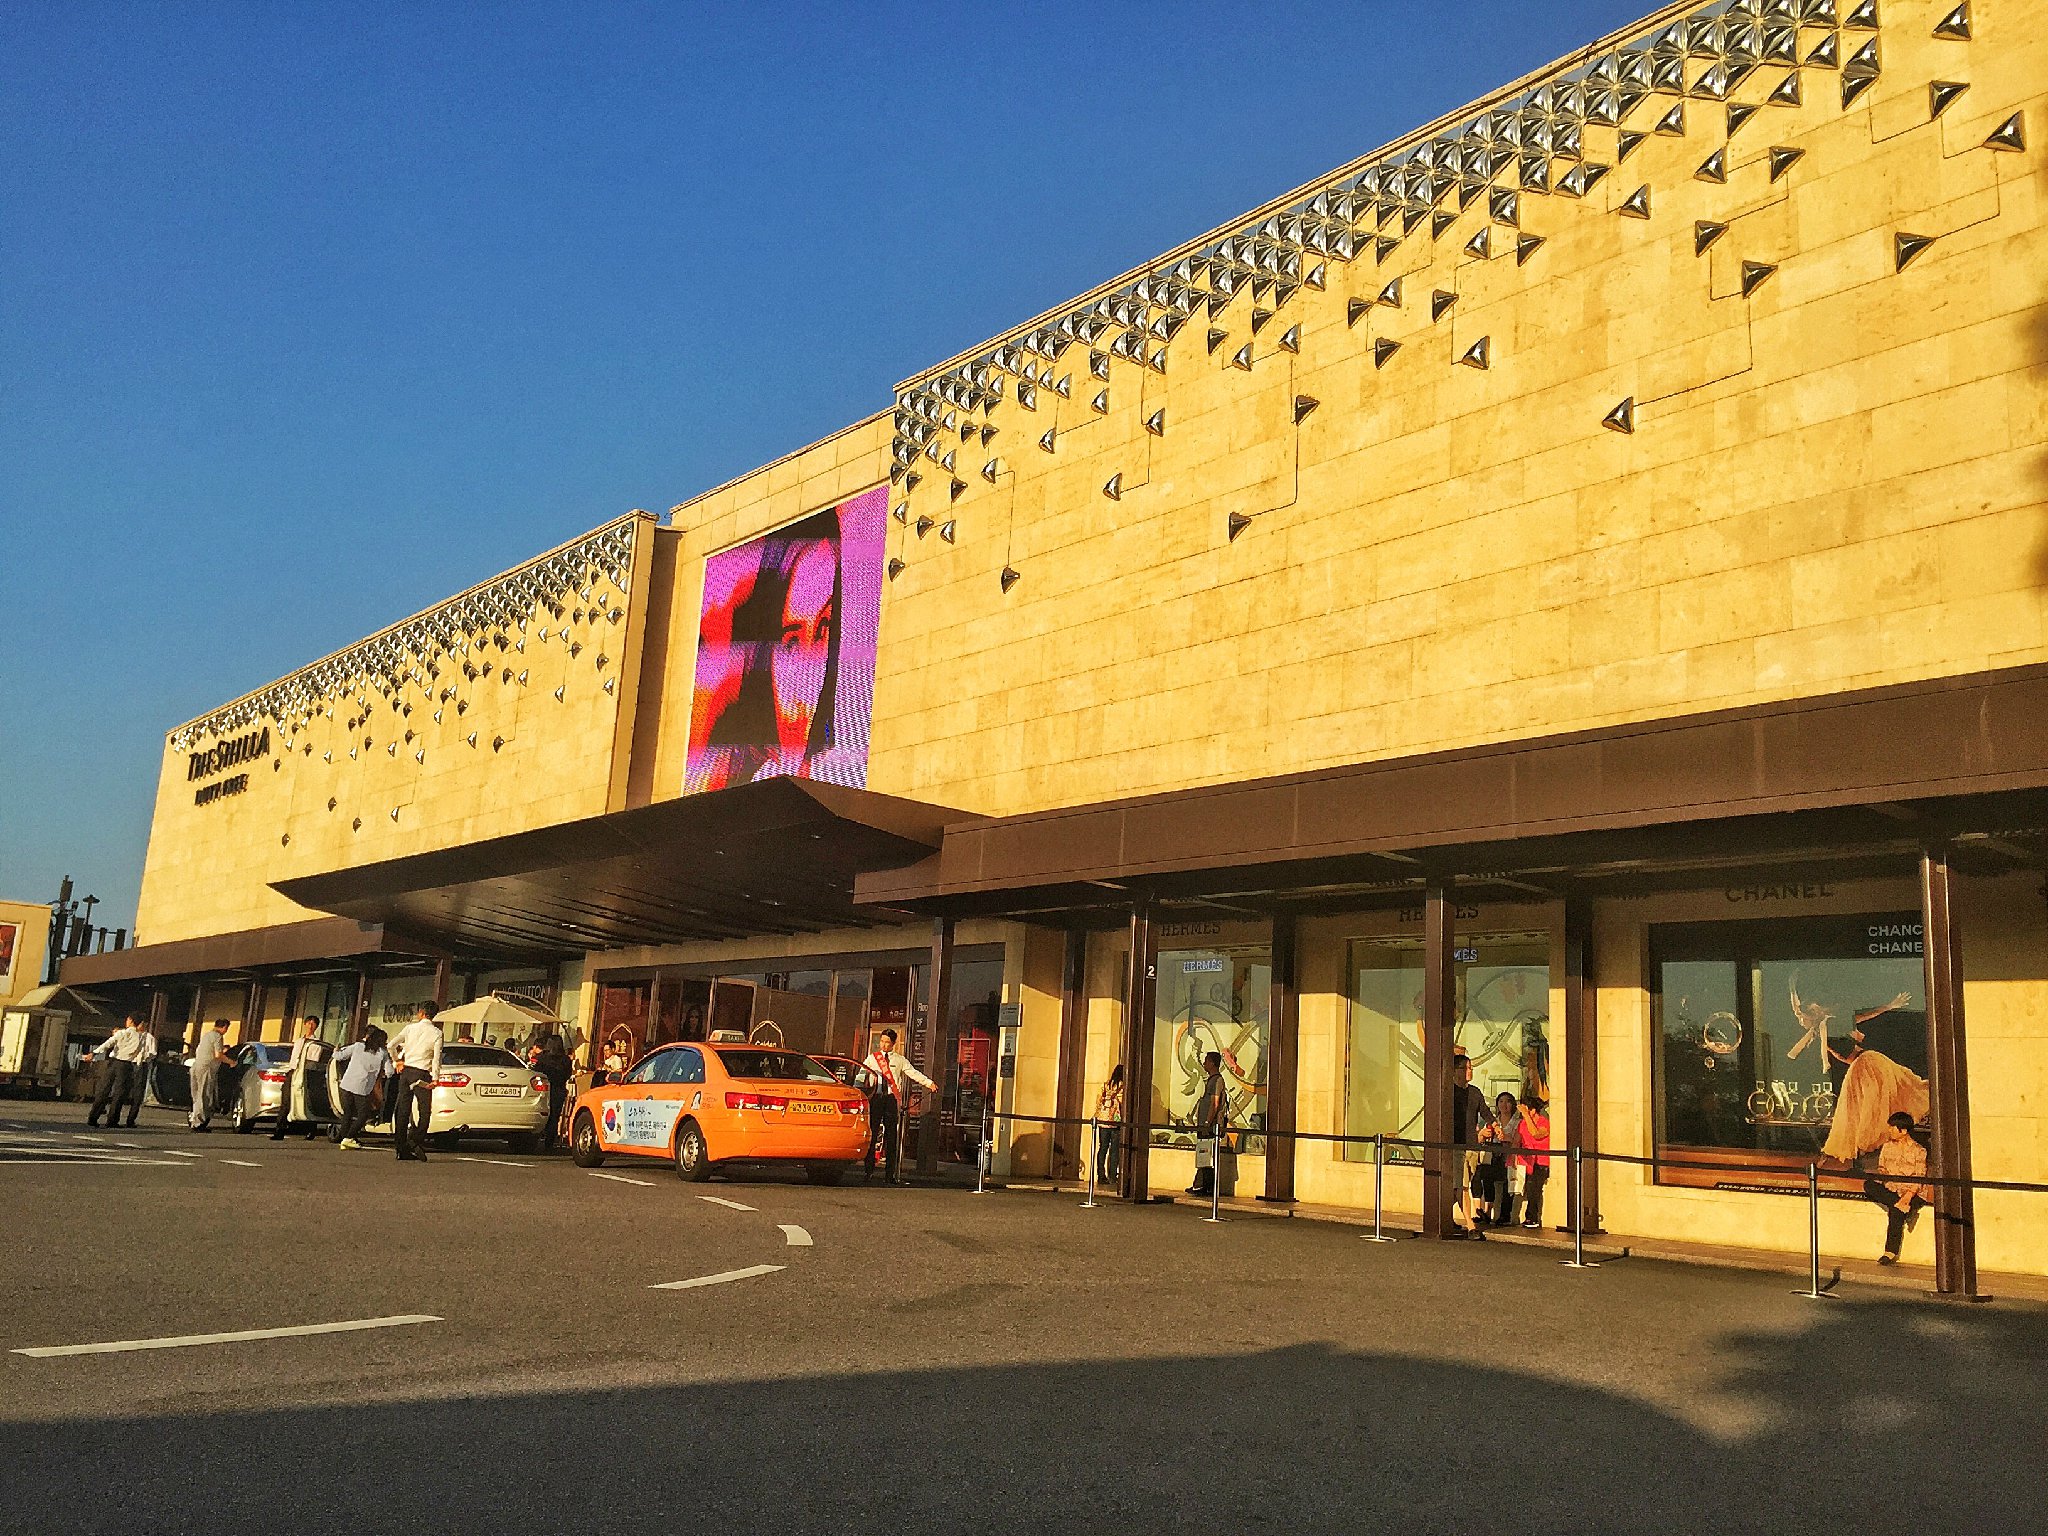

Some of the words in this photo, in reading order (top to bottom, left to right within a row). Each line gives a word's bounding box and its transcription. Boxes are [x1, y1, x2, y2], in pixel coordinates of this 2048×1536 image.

[1725, 883, 1834, 902] CHANEL
[1868, 925, 1924, 937] CHANC
[1868, 941, 1924, 955] CHANE
[1147, 965, 1155, 977] 2
